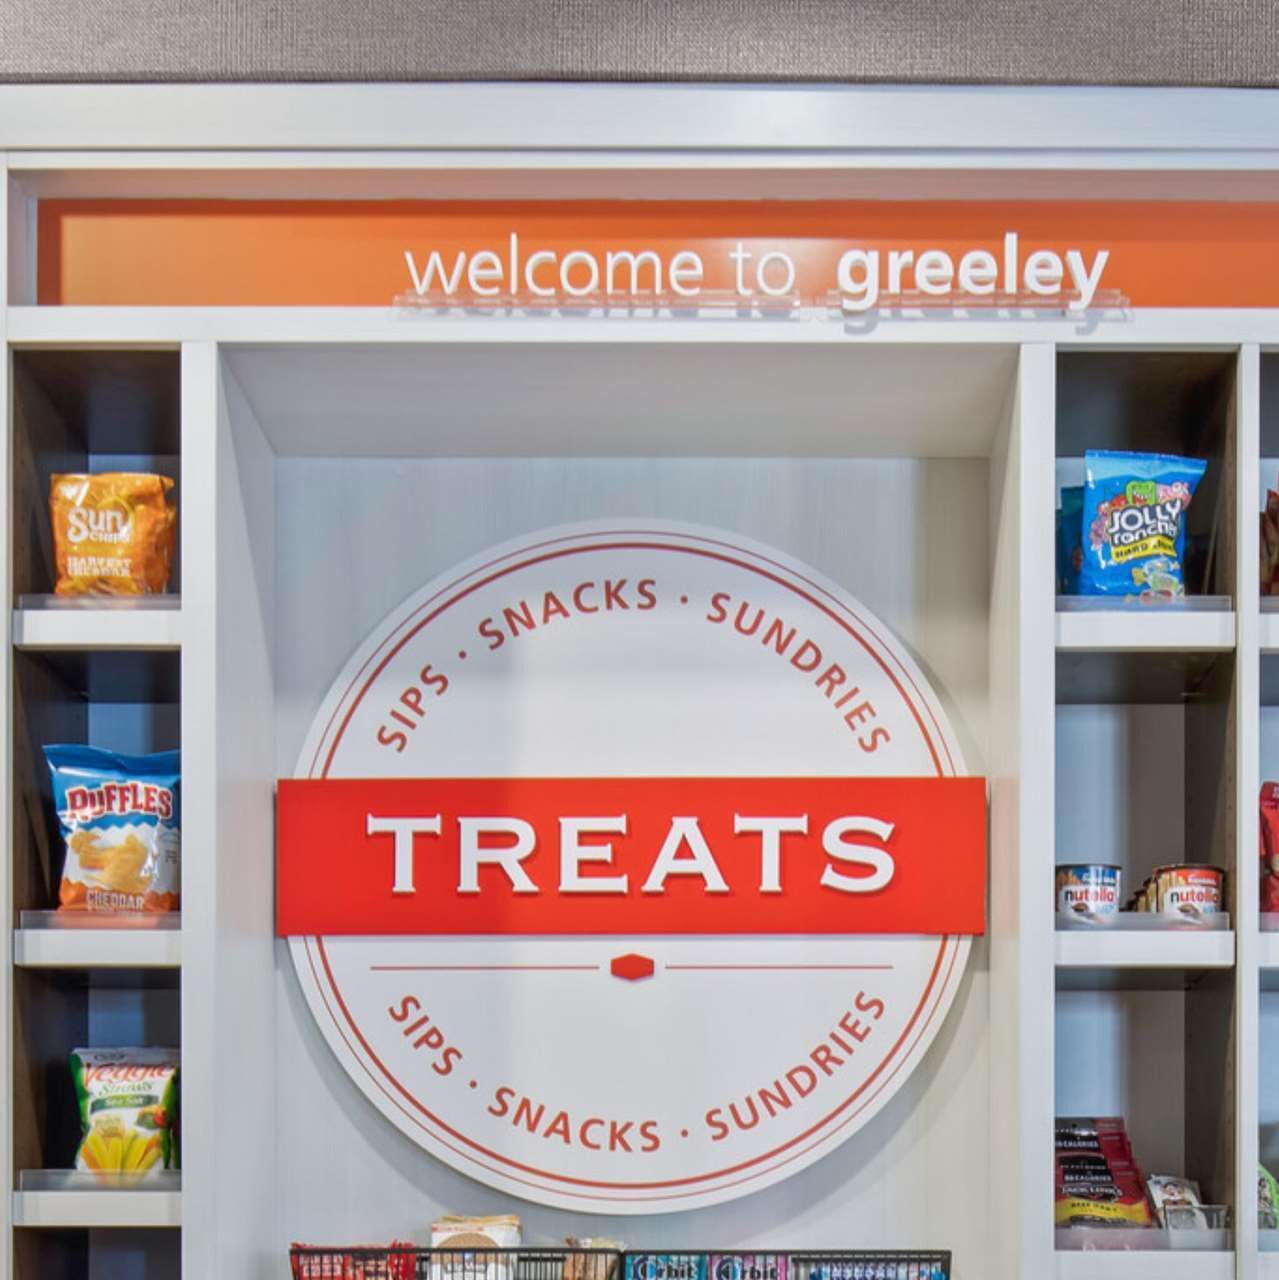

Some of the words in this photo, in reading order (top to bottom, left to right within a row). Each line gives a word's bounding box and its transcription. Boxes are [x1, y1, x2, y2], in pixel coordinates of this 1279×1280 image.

[403, 231, 703, 297] welcome
[729, 241, 796, 297] to
[837, 231, 1110, 310] greeley
[67, 507, 123, 543] Sun
[1109, 500, 1181, 533] JOLLY
[376, 663, 451, 753] SIPS
[477, 578, 659, 651] SNACKS
[706, 592, 893, 753] SUNDRIES
[67, 782, 173, 820] RUFFLES
[366, 813, 896, 895] TREATS
[1065, 888, 1114, 902] nutella
[1170, 888, 1219, 902] nutella
[387, 994, 463, 1077] SIPS
[486, 1086, 662, 1153] SNACKS
[705, 990, 886, 1143] SUNDRIES
